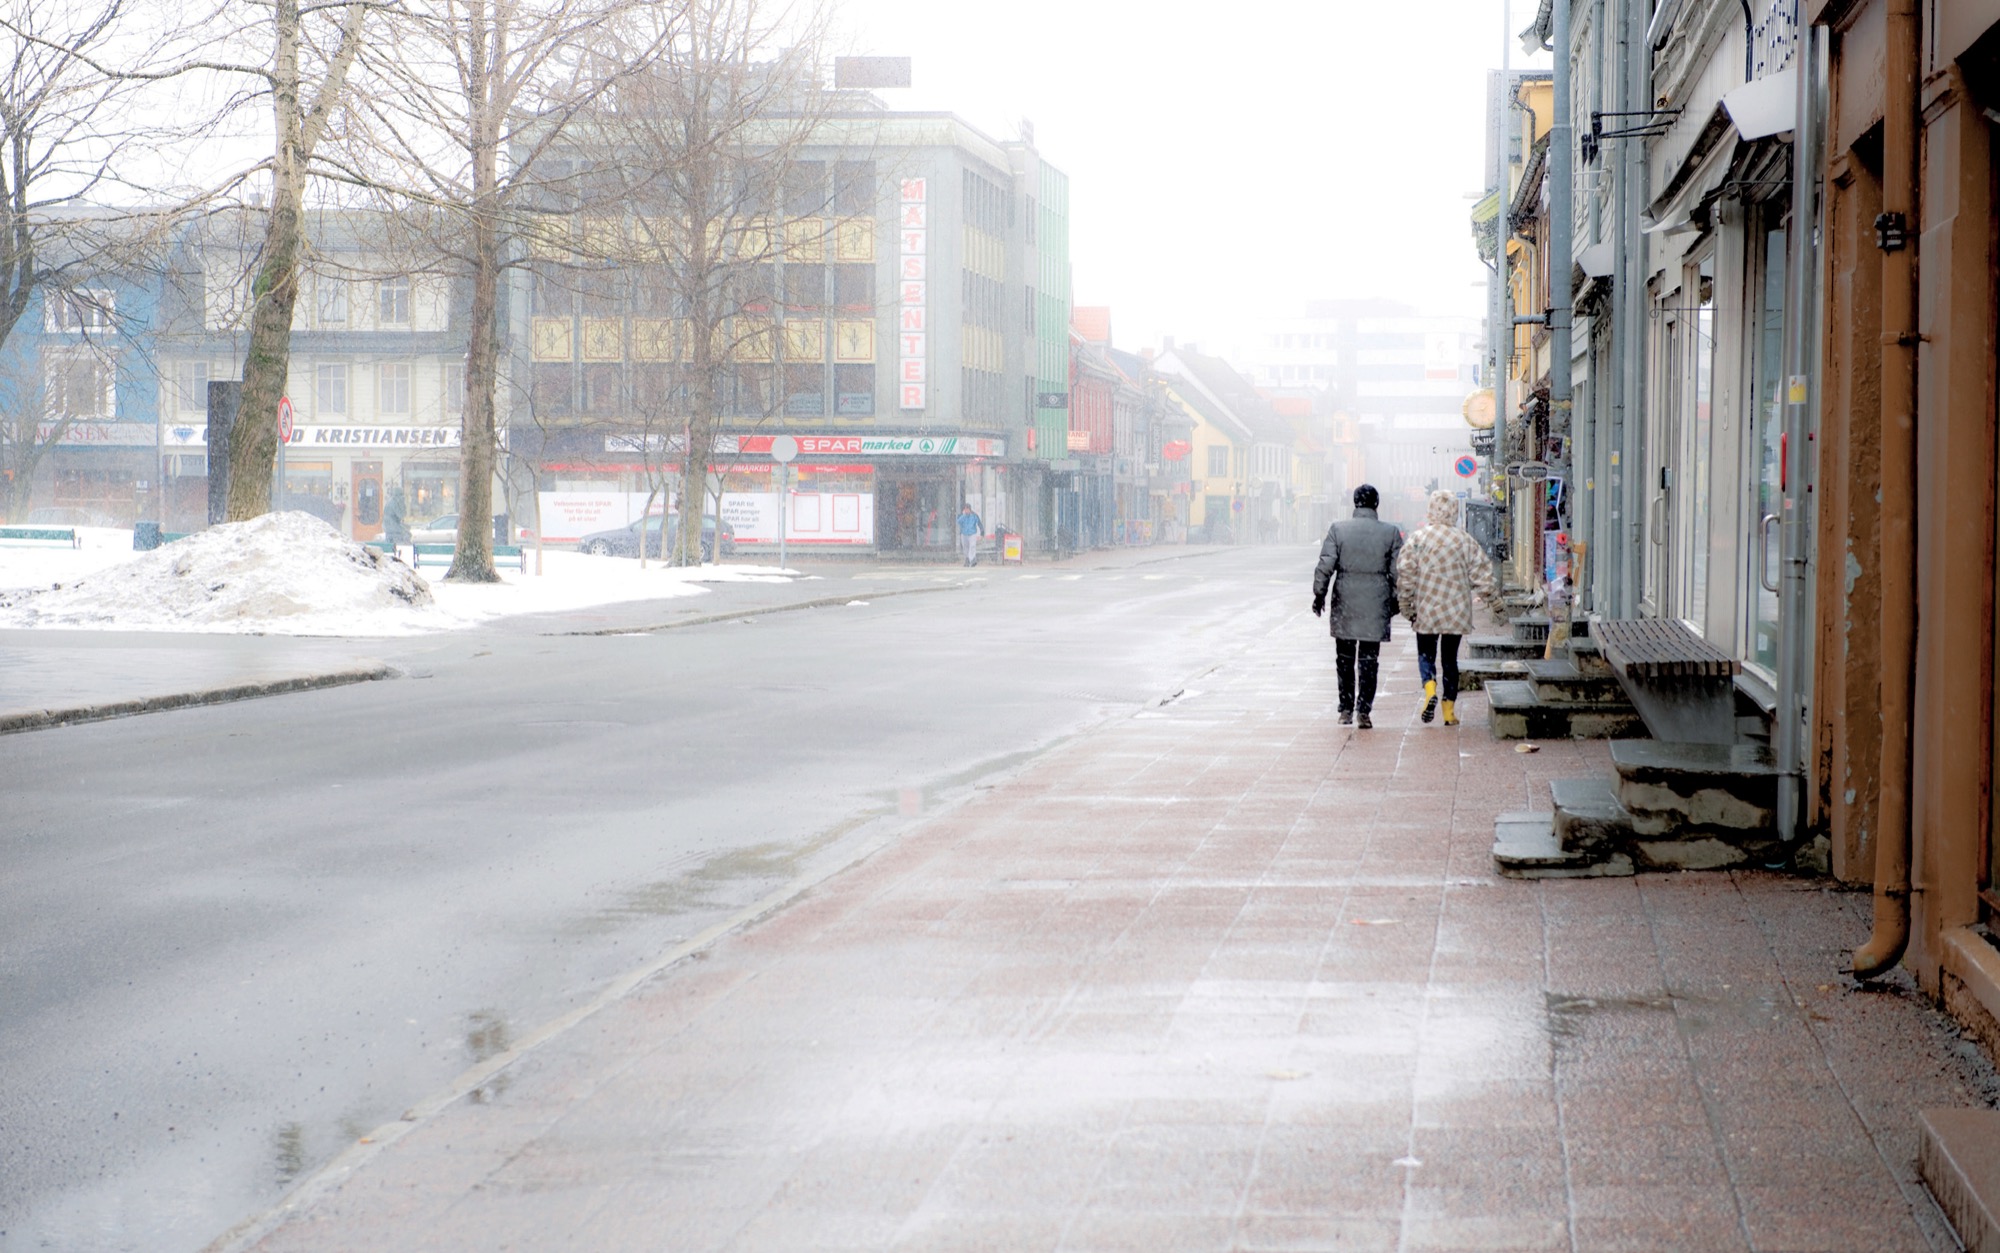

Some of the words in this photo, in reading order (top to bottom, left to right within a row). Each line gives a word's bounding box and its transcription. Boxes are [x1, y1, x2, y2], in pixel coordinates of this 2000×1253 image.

[902, 179, 924, 406] MATSENTER
[315, 429, 448, 444] KRISTIANSEN
[803, 440, 861, 451] SPAR
[861, 439, 913, 451] marked
